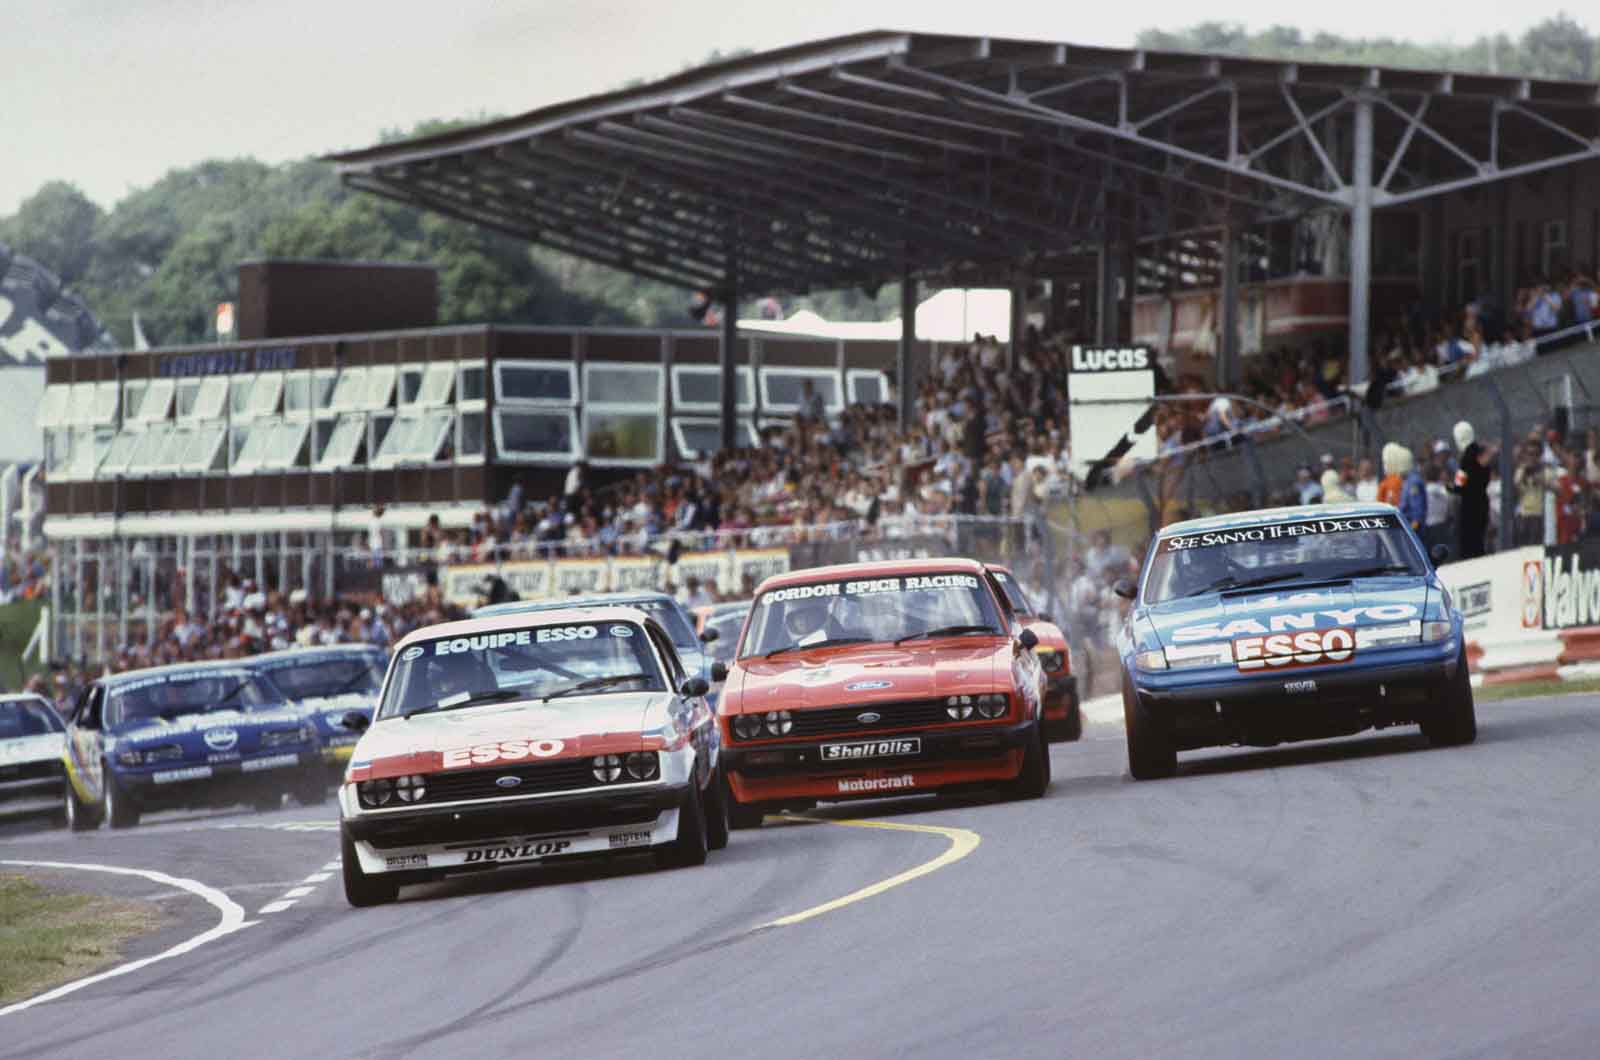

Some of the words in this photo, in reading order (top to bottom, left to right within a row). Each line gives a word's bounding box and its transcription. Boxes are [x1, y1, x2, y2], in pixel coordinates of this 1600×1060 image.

[1072, 345, 1148, 370] Lucas
[1168, 537, 1200, 551] SEE
[1264, 524, 1317, 540] THEN
[1319, 518, 1390, 533] DECIDE
[762, 583, 840, 605] GORDON
[845, 578, 900, 594] SPICE
[905, 574, 978, 590] RACING
[1172, 604, 1418, 642] SANYO
[435, 631, 531, 656] EQUIPE
[536, 626, 598, 643] ESSO
[1236, 629, 1353, 669] ESSO
[442, 740, 565, 768] ESSO
[829, 743, 874, 758] Shell
[878, 742, 912, 754] Oils
[838, 774, 915, 792] Motorcraft
[464, 840, 571, 863] DUNLOP
